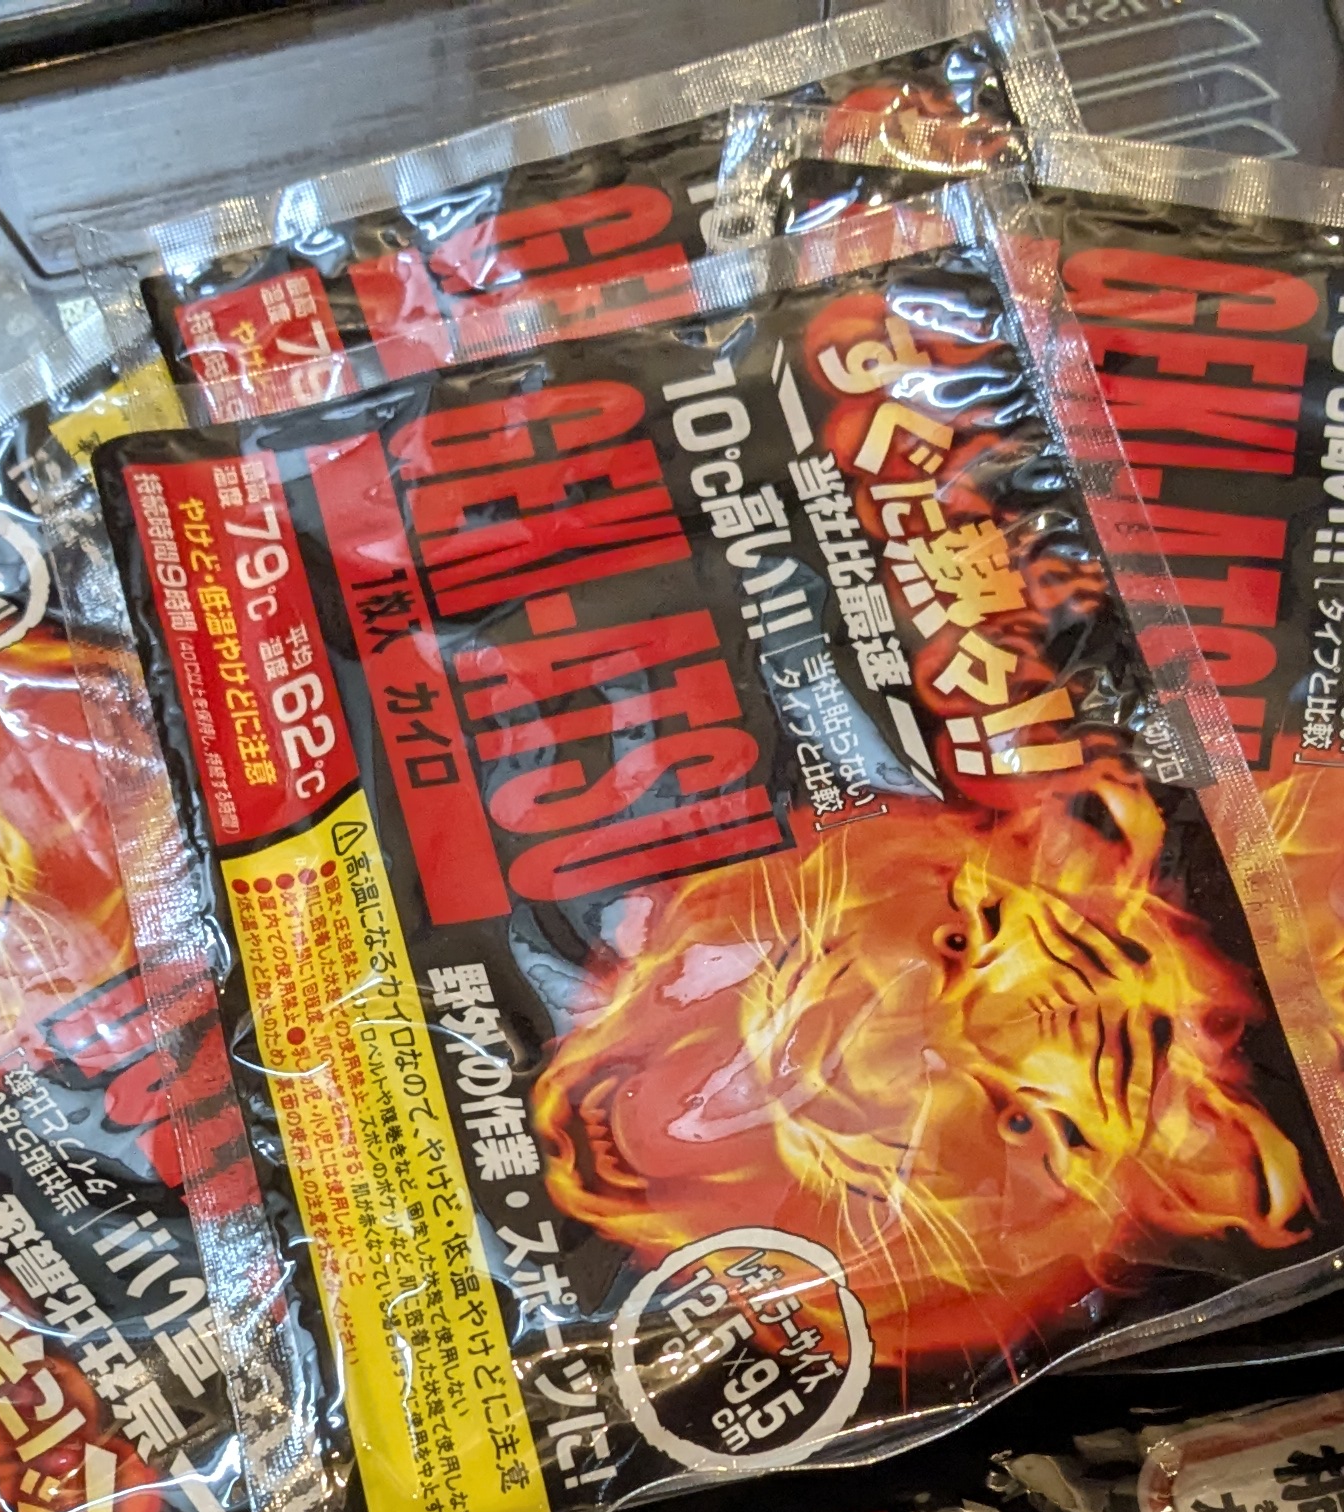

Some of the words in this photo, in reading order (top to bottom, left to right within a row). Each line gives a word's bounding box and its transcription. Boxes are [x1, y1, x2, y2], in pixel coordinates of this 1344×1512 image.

[213, 465, 244, 508] 温度
[788, 452, 912, 692] 当社比最速
[178, 496, 278, 786] やけど・低温やけどに注意
[259, 636, 289, 681] 温度
[285, 623, 314, 671] 平均
[383, 682, 461, 790] カイロ
[769, 668, 844, 816] タイプと比較
[802, 652, 877, 807] 当社貼らない
[1144, 721, 1185, 784] 切り口
[3, 1060, 117, 1200] タイプと比較
